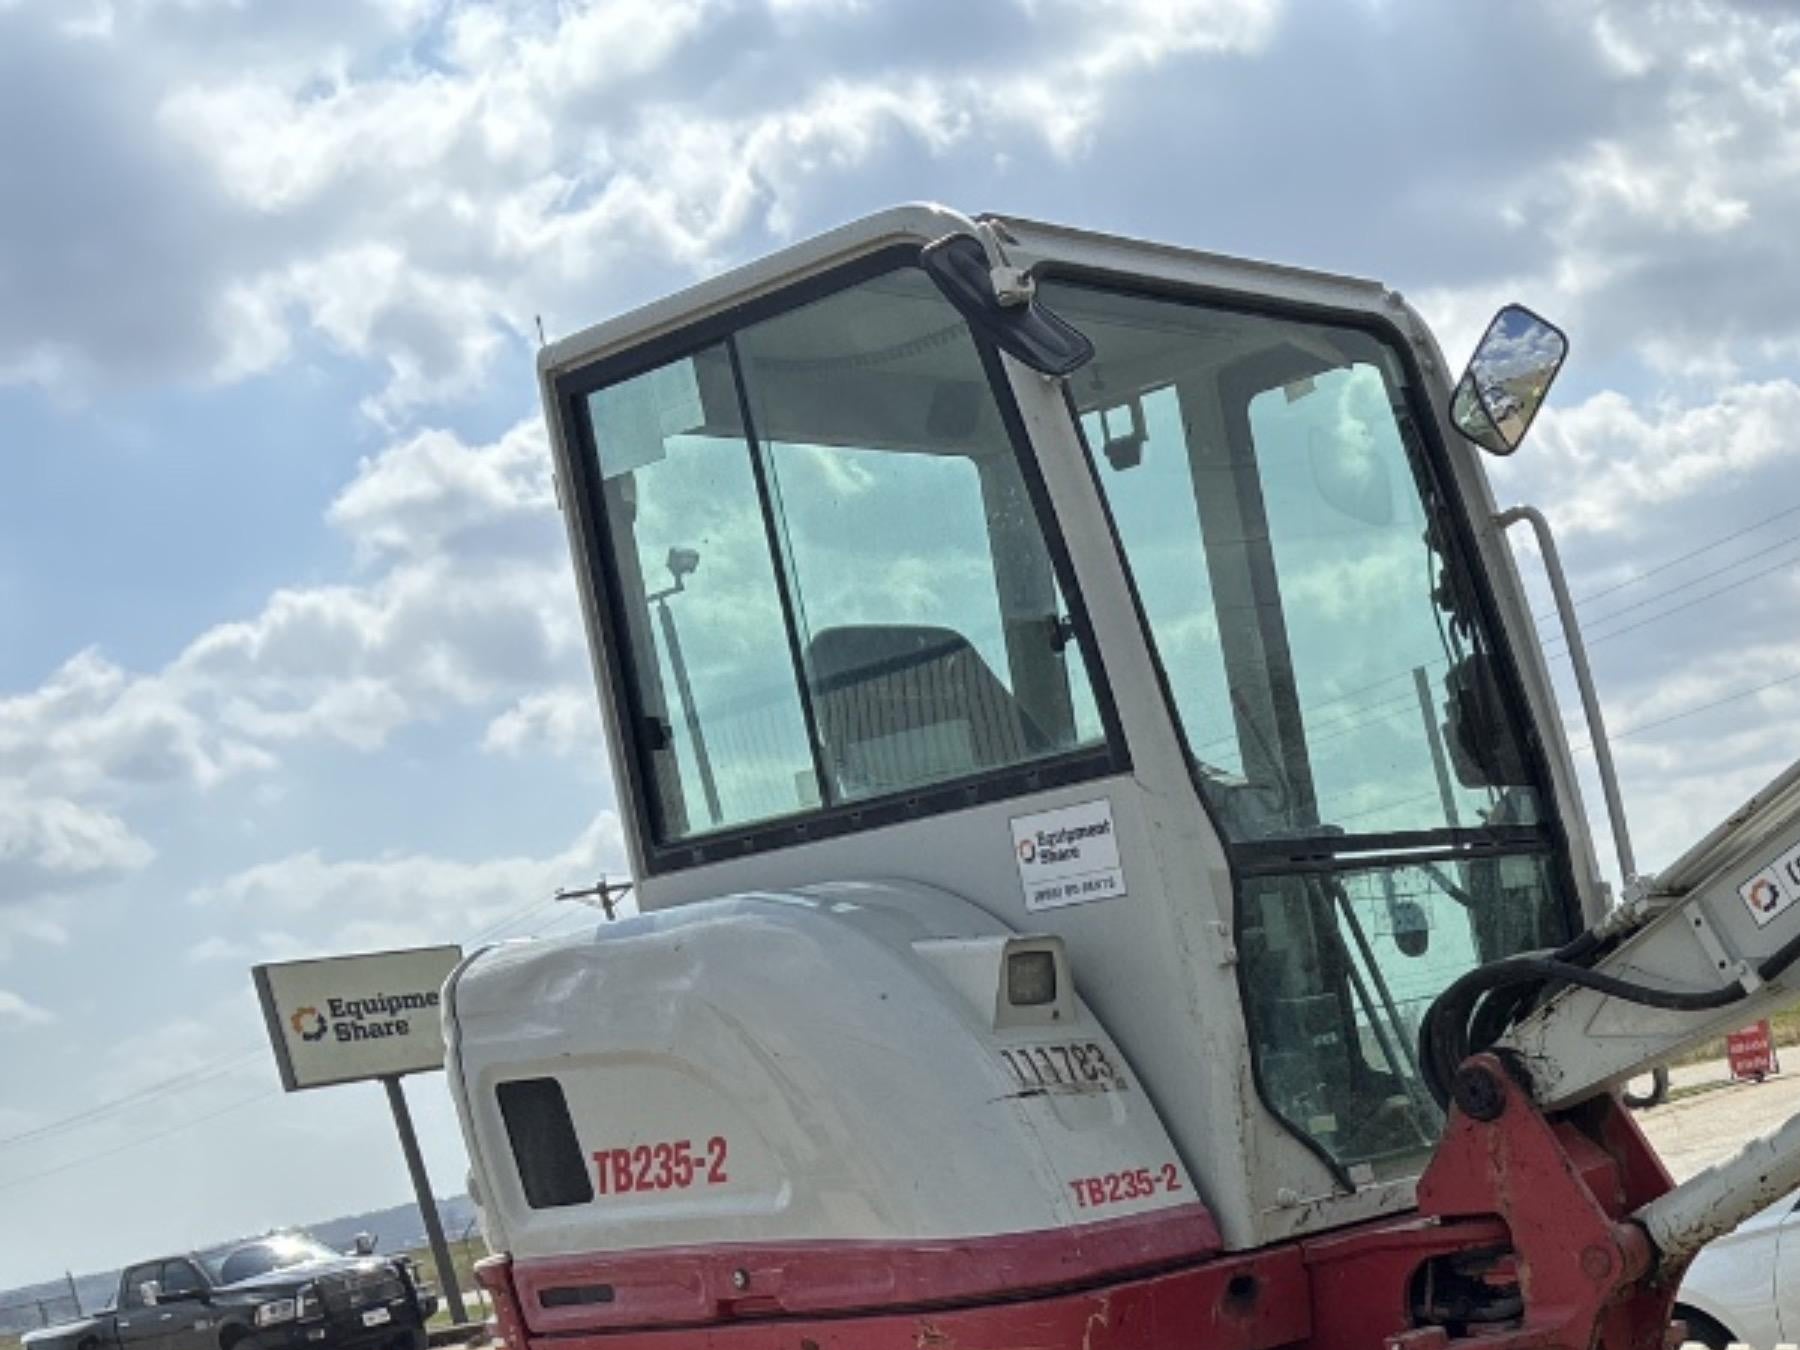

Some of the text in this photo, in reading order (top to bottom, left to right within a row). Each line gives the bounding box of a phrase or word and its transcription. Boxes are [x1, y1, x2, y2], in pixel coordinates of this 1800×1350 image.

[327, 989, 440, 1020] Equipme
[333, 1016, 410, 1042] Share
[592, 1135, 728, 1196] TB235-2
[1069, 1162, 1182, 1208] TB235-2
